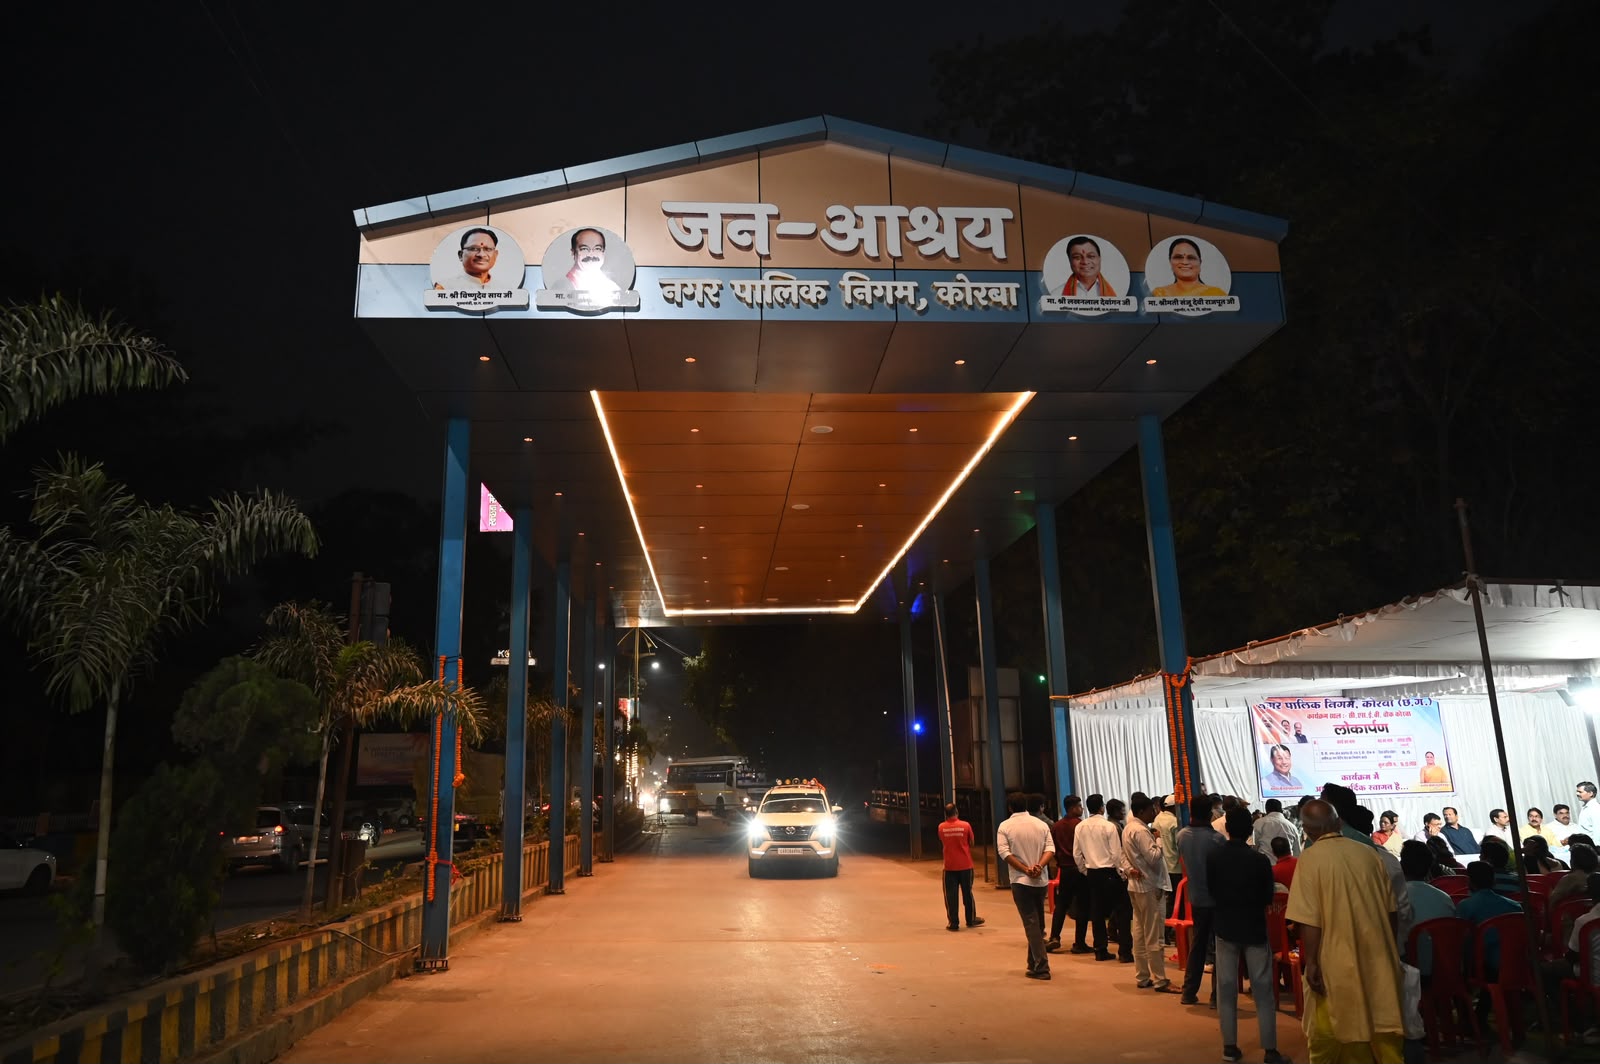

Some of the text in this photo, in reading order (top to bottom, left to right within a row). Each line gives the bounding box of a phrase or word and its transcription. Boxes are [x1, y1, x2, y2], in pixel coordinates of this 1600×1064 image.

[661, 201, 1014, 259] जन-आश्रय
[450, 291, 459, 299] श्री
[503, 291, 512, 299] जी
[659, 271, 1020, 312] नगर पालिक निगम, कोरबा
[1285, 699, 1321, 709] पालिक
[1333, 720, 1389, 735] लोकार्पण
[1341, 773, 1371, 781] कार्यक्रम
